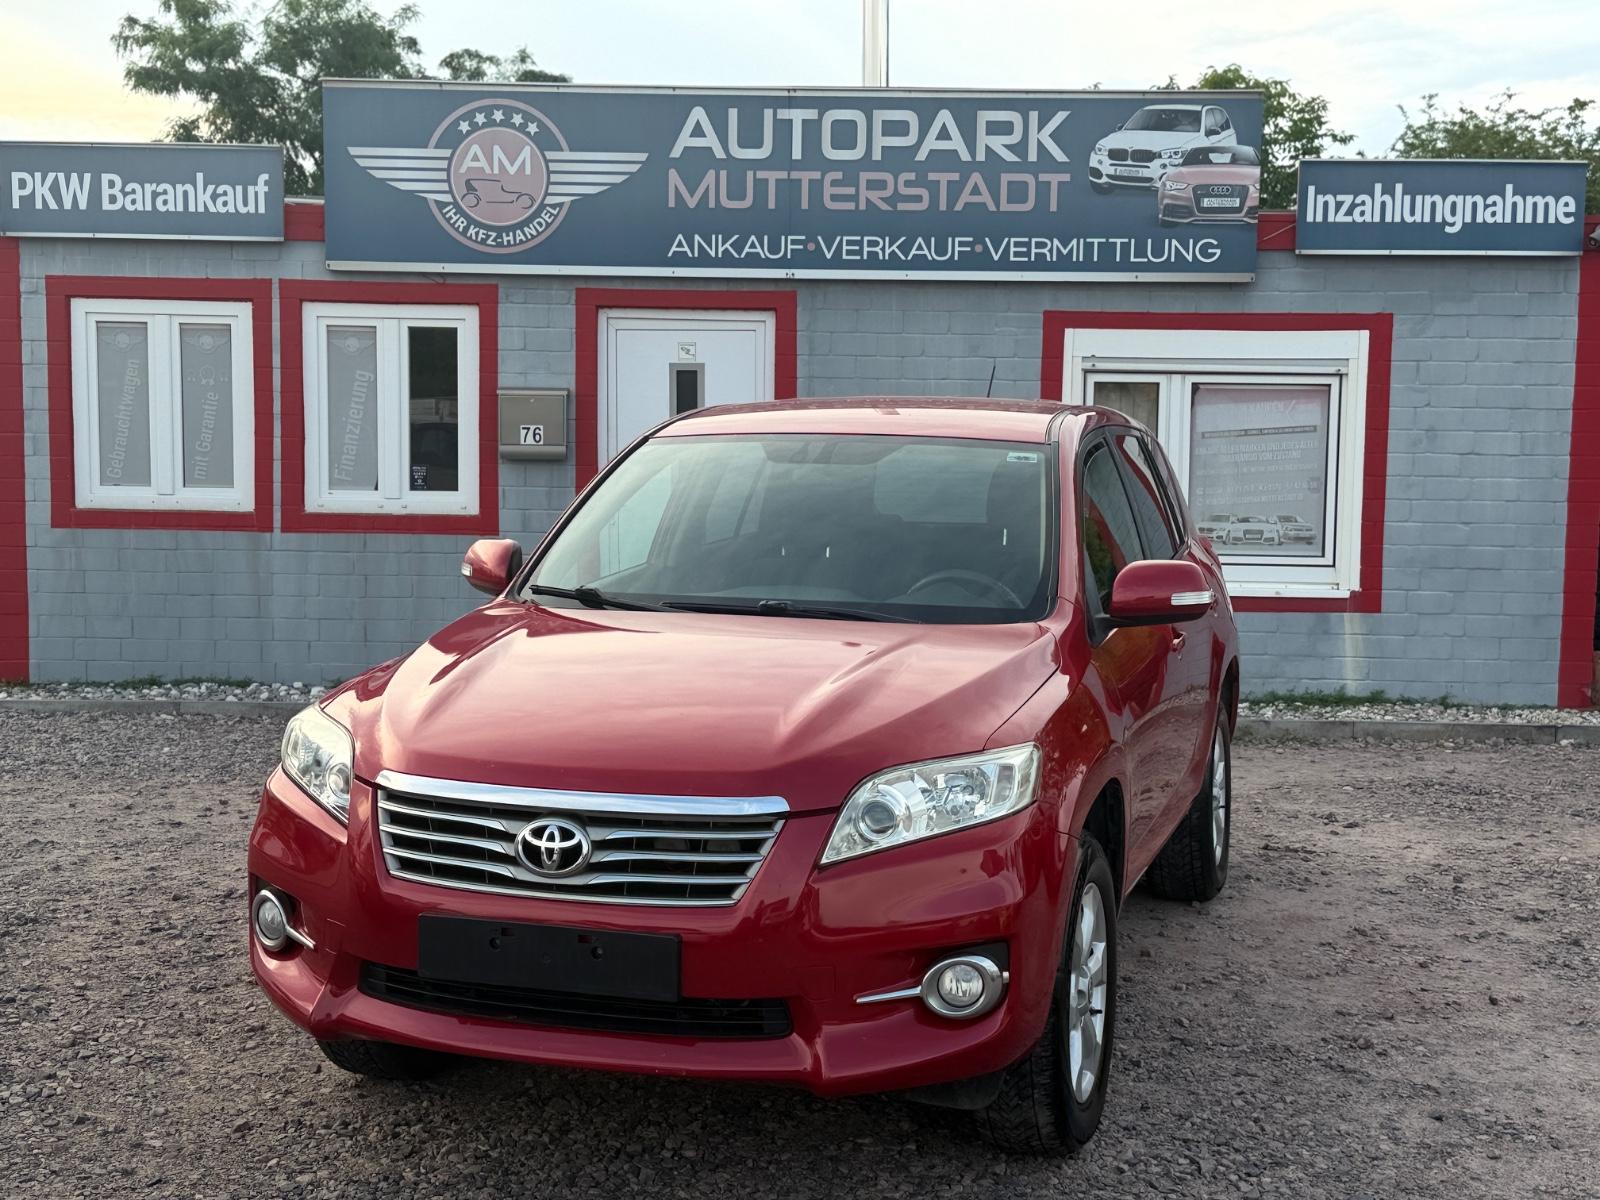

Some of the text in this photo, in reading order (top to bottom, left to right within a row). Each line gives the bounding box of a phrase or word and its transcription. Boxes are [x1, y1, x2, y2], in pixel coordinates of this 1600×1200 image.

[669, 105, 1071, 162] AUTOPARK
[458, 144, 532, 176] AM
[10, 171, 270, 215] PKW Barankauf
[668, 168, 1071, 212] MUTTERSTADT
[1306, 182, 1577, 234] Inzahlungnahme
[442, 204, 560, 246] IHR KFZ-HANDEL
[106, 359, 140, 479] Gebrauchtwagen
[192, 391, 220, 480] mit Garantie
[334, 369, 375, 482] Finanzierung
[521, 426, 543, 444] 76
